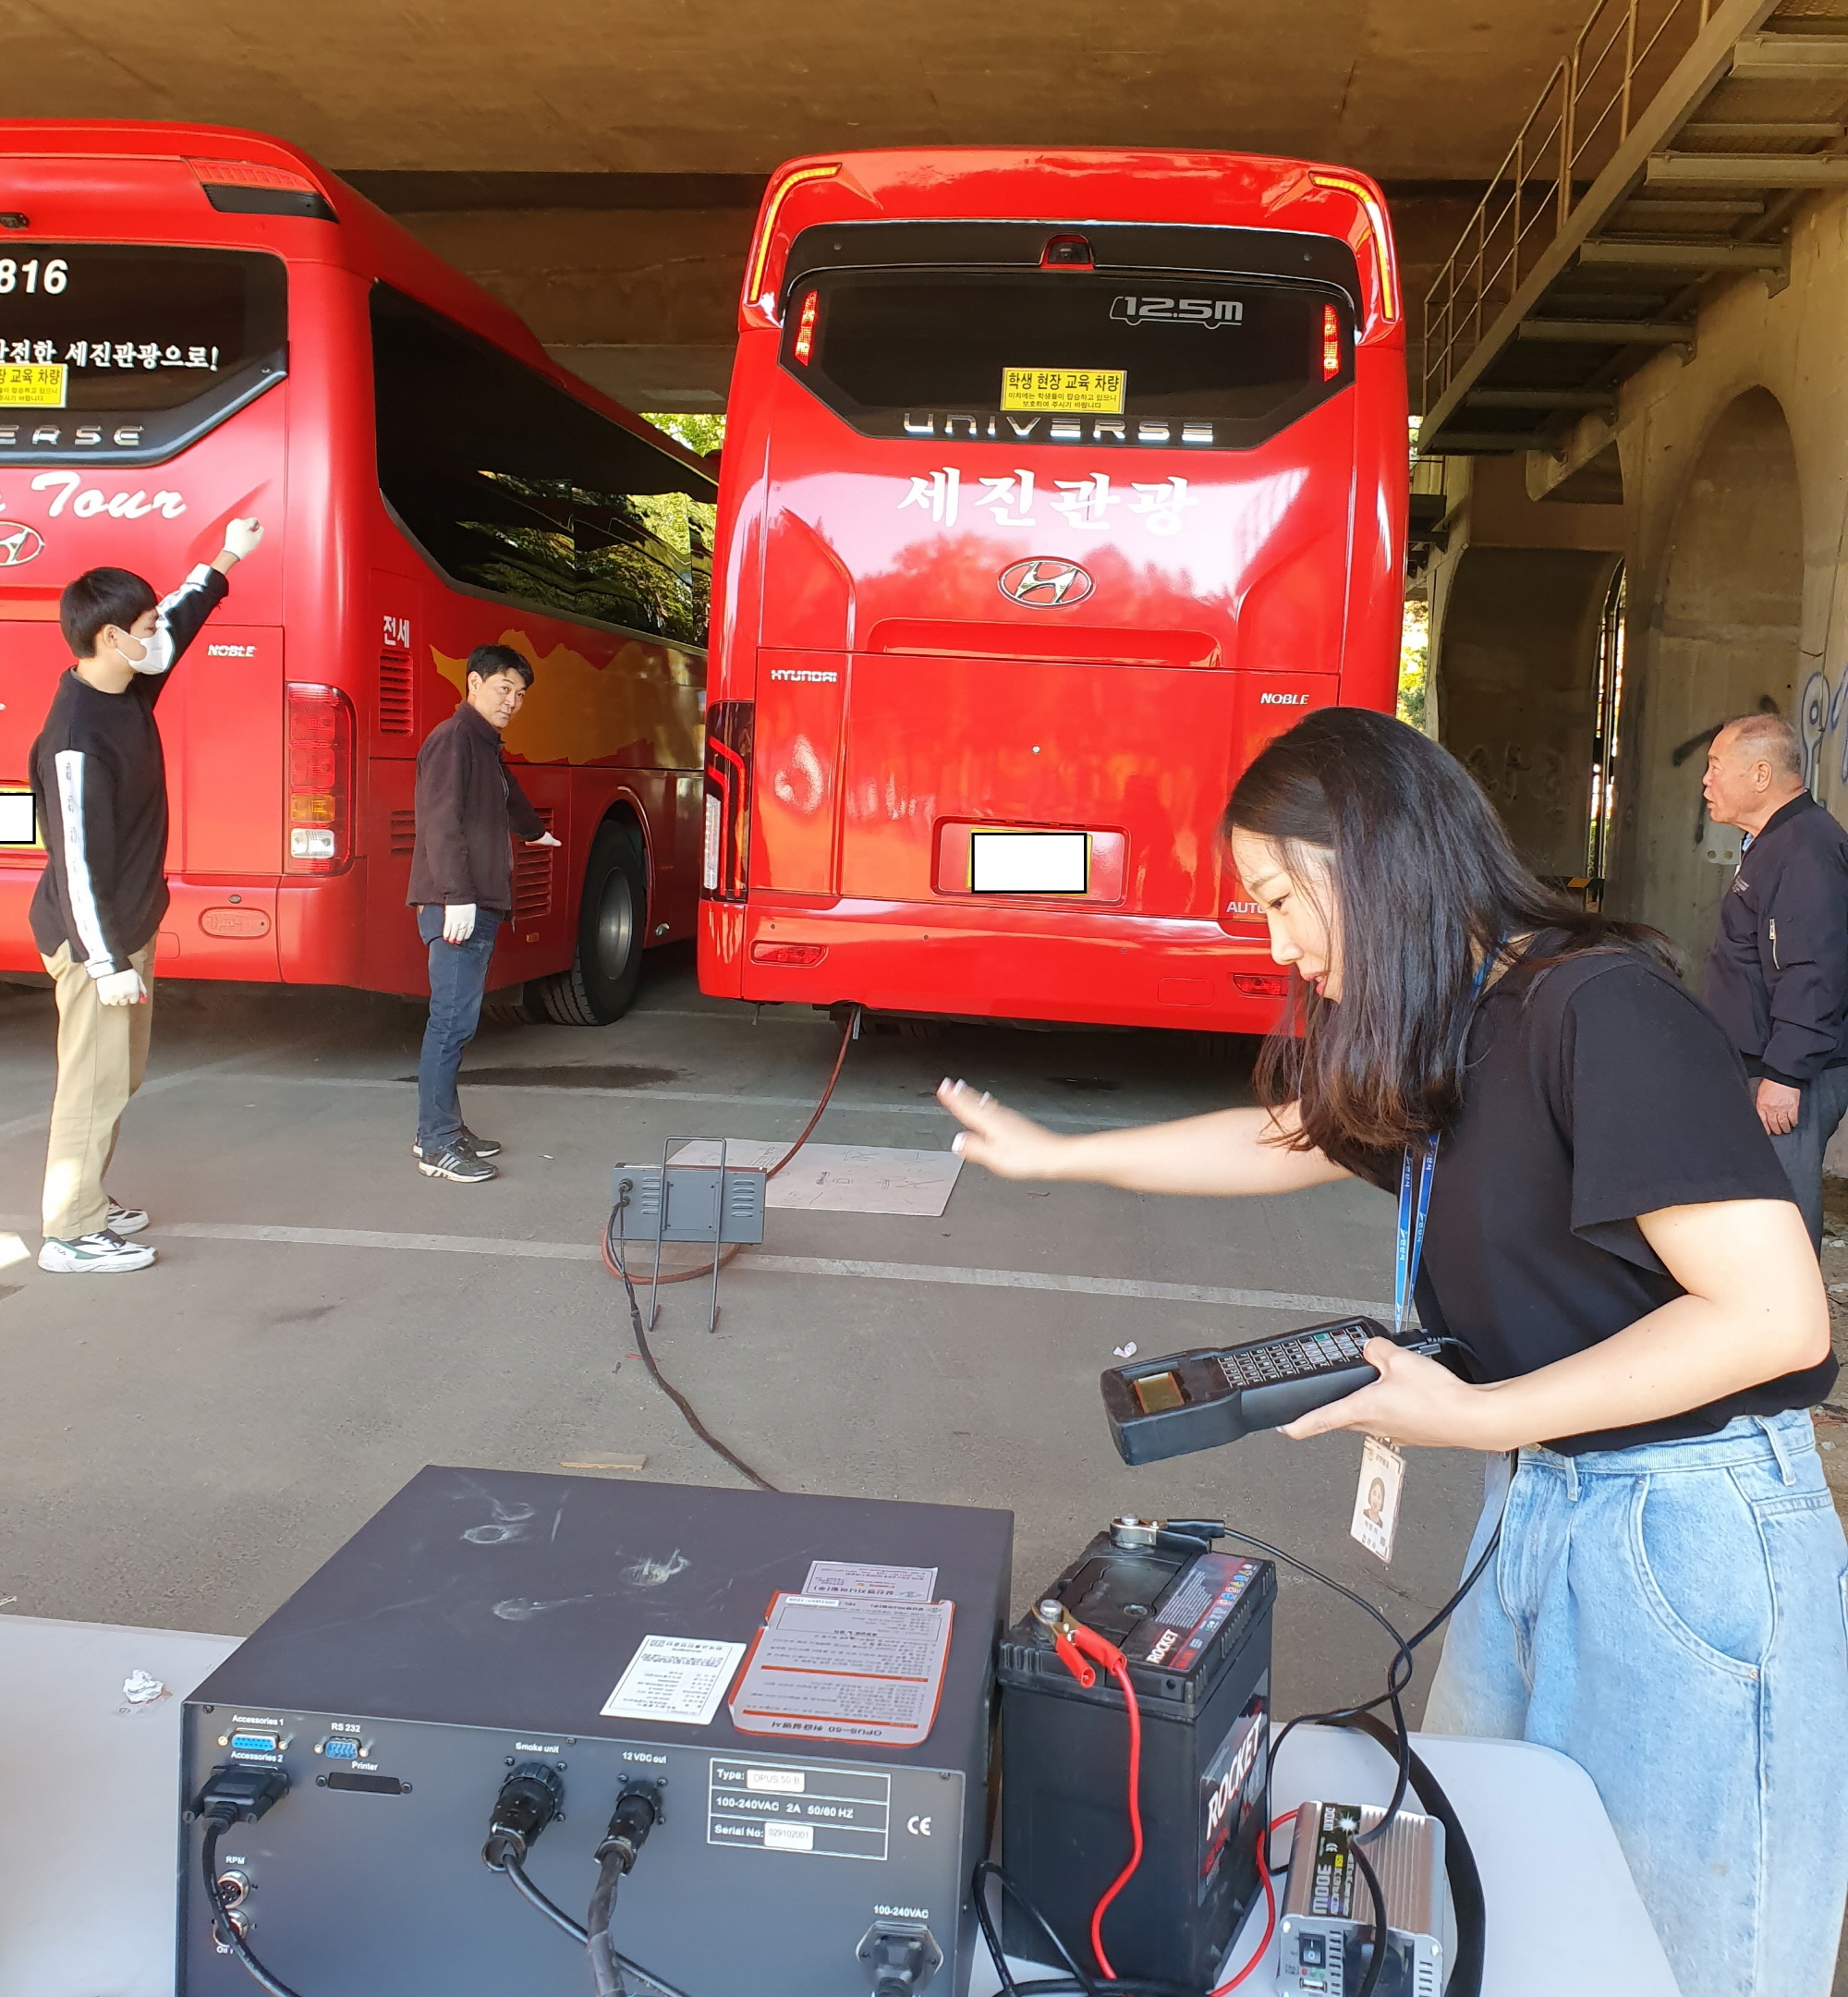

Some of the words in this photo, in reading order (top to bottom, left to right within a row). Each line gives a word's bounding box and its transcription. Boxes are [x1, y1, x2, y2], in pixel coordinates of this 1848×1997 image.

[0, 259, 68, 294] 816
[65, 340, 219, 371] 세진관광으로!
[10, 369, 33, 384] 교육
[38, 369, 61, 385] 차량
[1009, 372, 1032, 390] 학생
[1038, 373, 1061, 390] 현장
[1065, 374, 1090, 391] 교육
[1095, 375, 1120, 392] 차량
[904, 412, 1213, 443] UNIVERSE
[30, 470, 188, 519] Tour
[896, 466, 1199, 536] 세진관광
[383, 615, 410, 648] 전세
[207, 644, 257, 658] NOBLE
[771, 669, 838, 683] HYUNDAI
[1259, 692, 1310, 705] NOBLE
[1146, 1629, 1179, 1664] ROCKET
[232, 1714, 277, 1725] Accessories
[278, 1718, 284, 1726] 1
[331, 1723, 344, 1732] RS
[345, 1723, 361, 1733] 232
[516, 1741, 542, 1752] Smoke
[543, 1745, 559, 1754] unit
[231, 1750, 275, 1762] Accessories
[276, 1754, 283, 1763] 2
[622, 1750, 633, 1761] 12
[634, 1752, 652, 1763] VDC
[653, 1754, 667, 1764] out
[352, 1760, 378, 1772] Printer
[716, 1768, 745, 1781] Type:
[753, 1772, 779, 1784] OPUS
[1206, 1711, 1263, 1840] ROCKET
[716, 1796, 780, 1812] 100-240VAC
[785, 1802, 801, 1814] 2A
[807, 1805, 837, 1818] 50/60
[838, 1807, 854, 1820] HZ
[714, 1823, 745, 1836] Serial
[746, 1826, 763, 1839] No:
[225, 1855, 246, 1865] RPM
[873, 1904, 930, 1919] 100-240VAC
